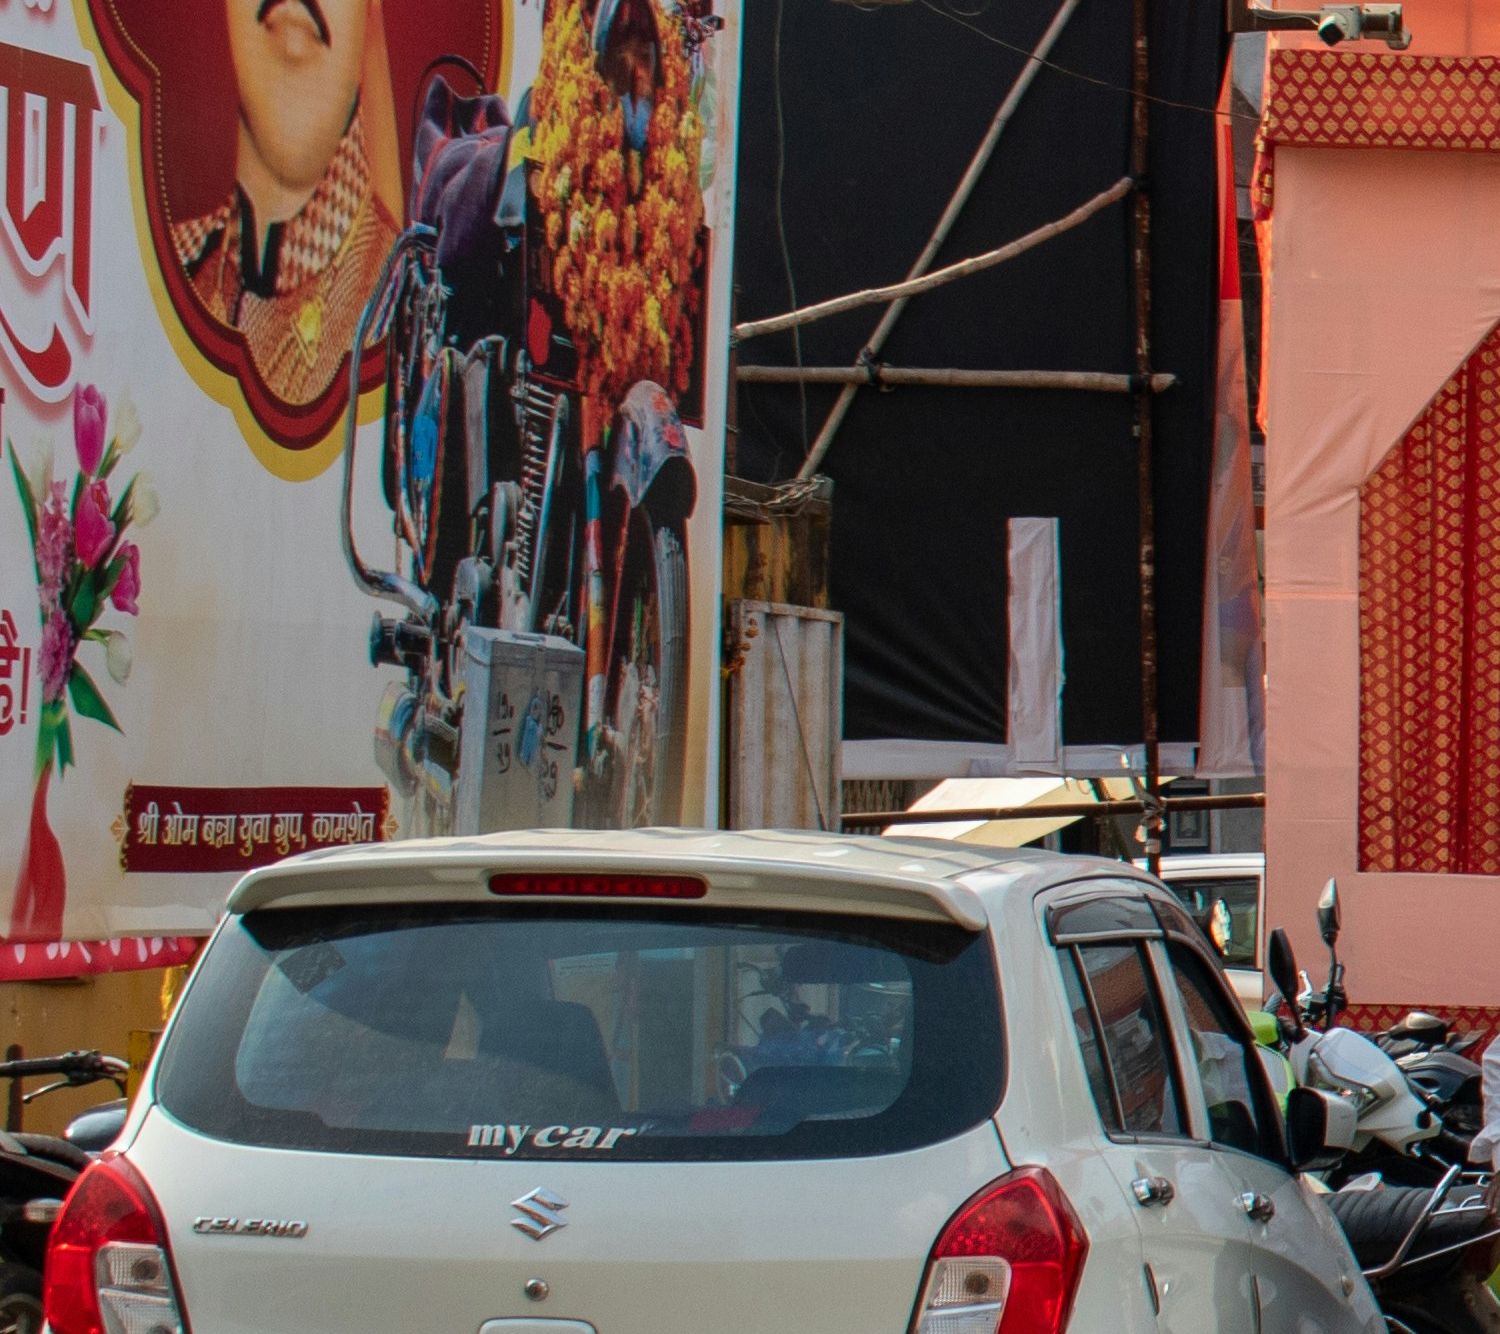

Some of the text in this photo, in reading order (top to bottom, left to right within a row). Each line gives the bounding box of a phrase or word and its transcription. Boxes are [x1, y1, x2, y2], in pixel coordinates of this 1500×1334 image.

[138, 802, 160, 845] श्री
[163, 802, 199, 846] ओम
[240, 814, 271, 856] युवा
[192, 1216, 308, 1238] CELERIO
